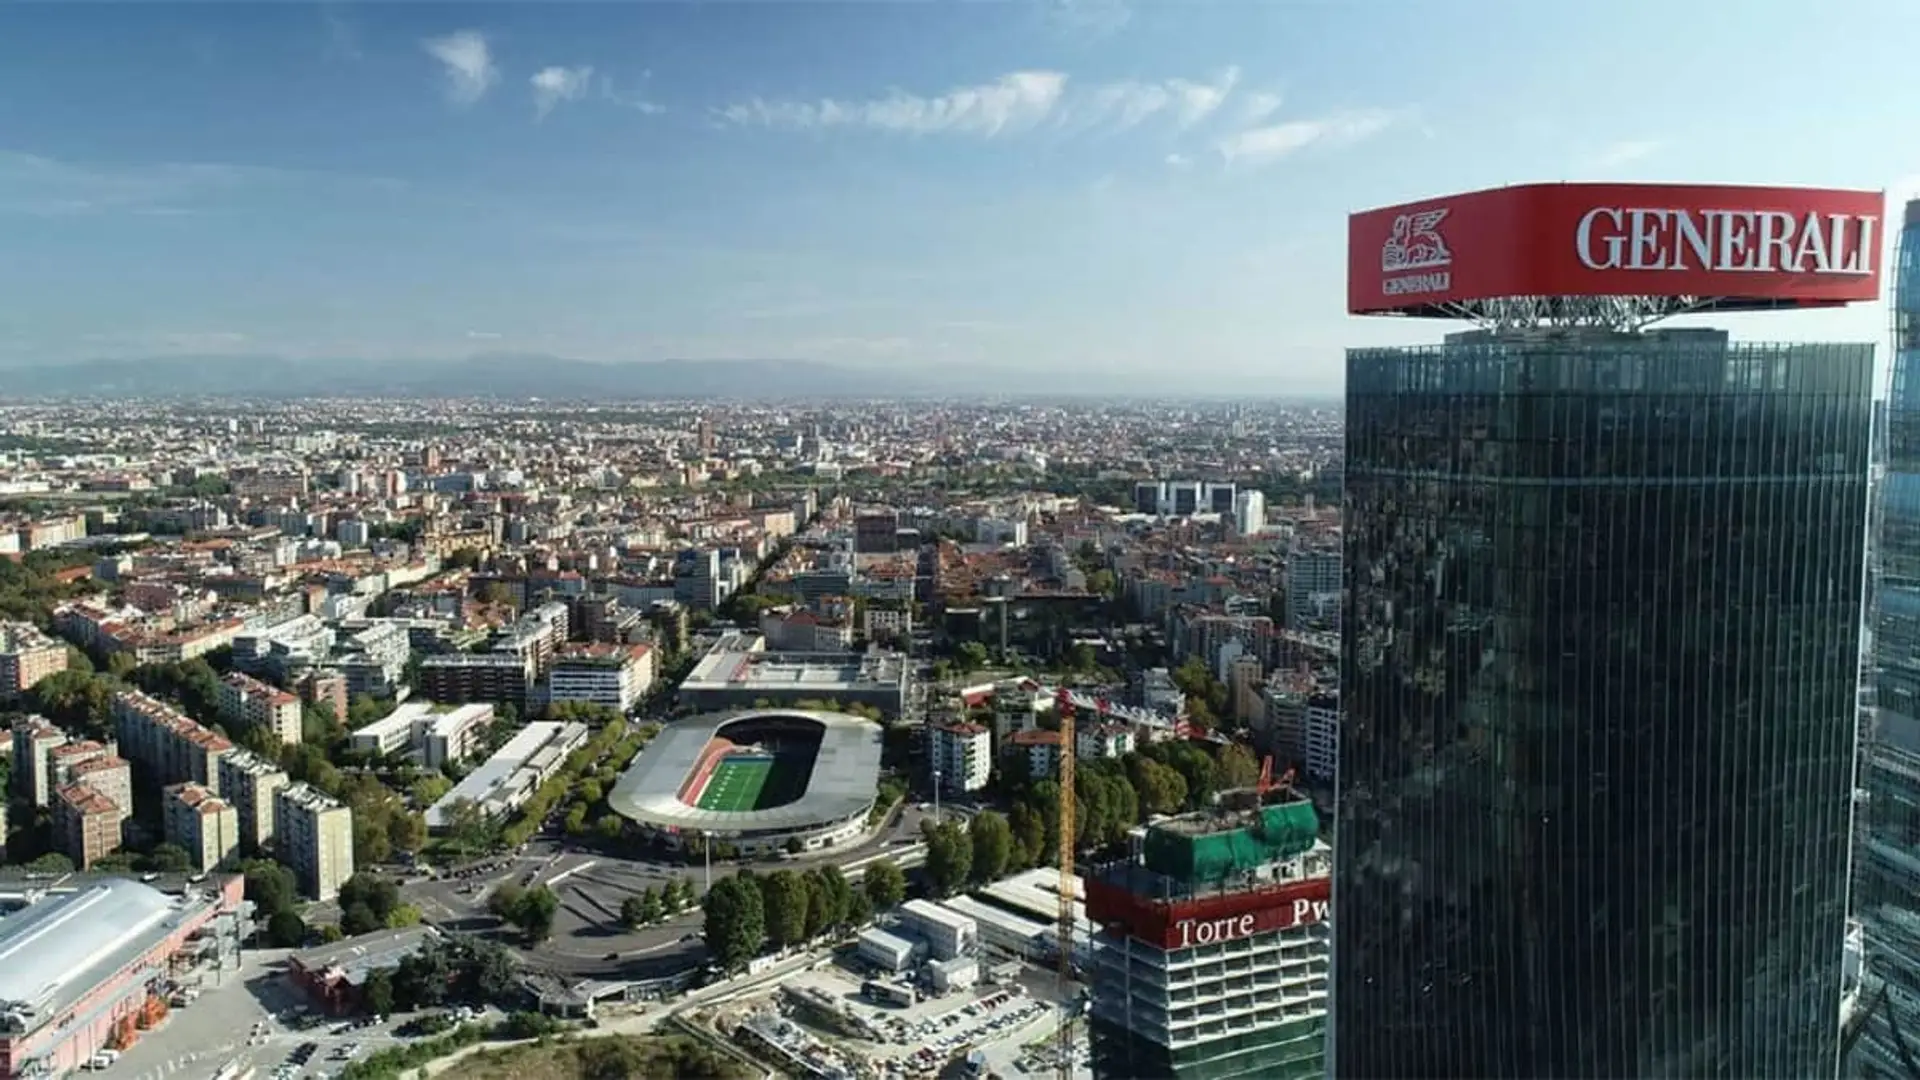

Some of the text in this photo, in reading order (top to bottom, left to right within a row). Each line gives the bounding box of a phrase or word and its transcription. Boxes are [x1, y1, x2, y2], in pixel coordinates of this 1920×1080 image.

[1577, 206, 1877, 273] GENERALI
[1382, 272, 1450, 295] GENERALI
[1177, 914, 1255, 947] Torre
